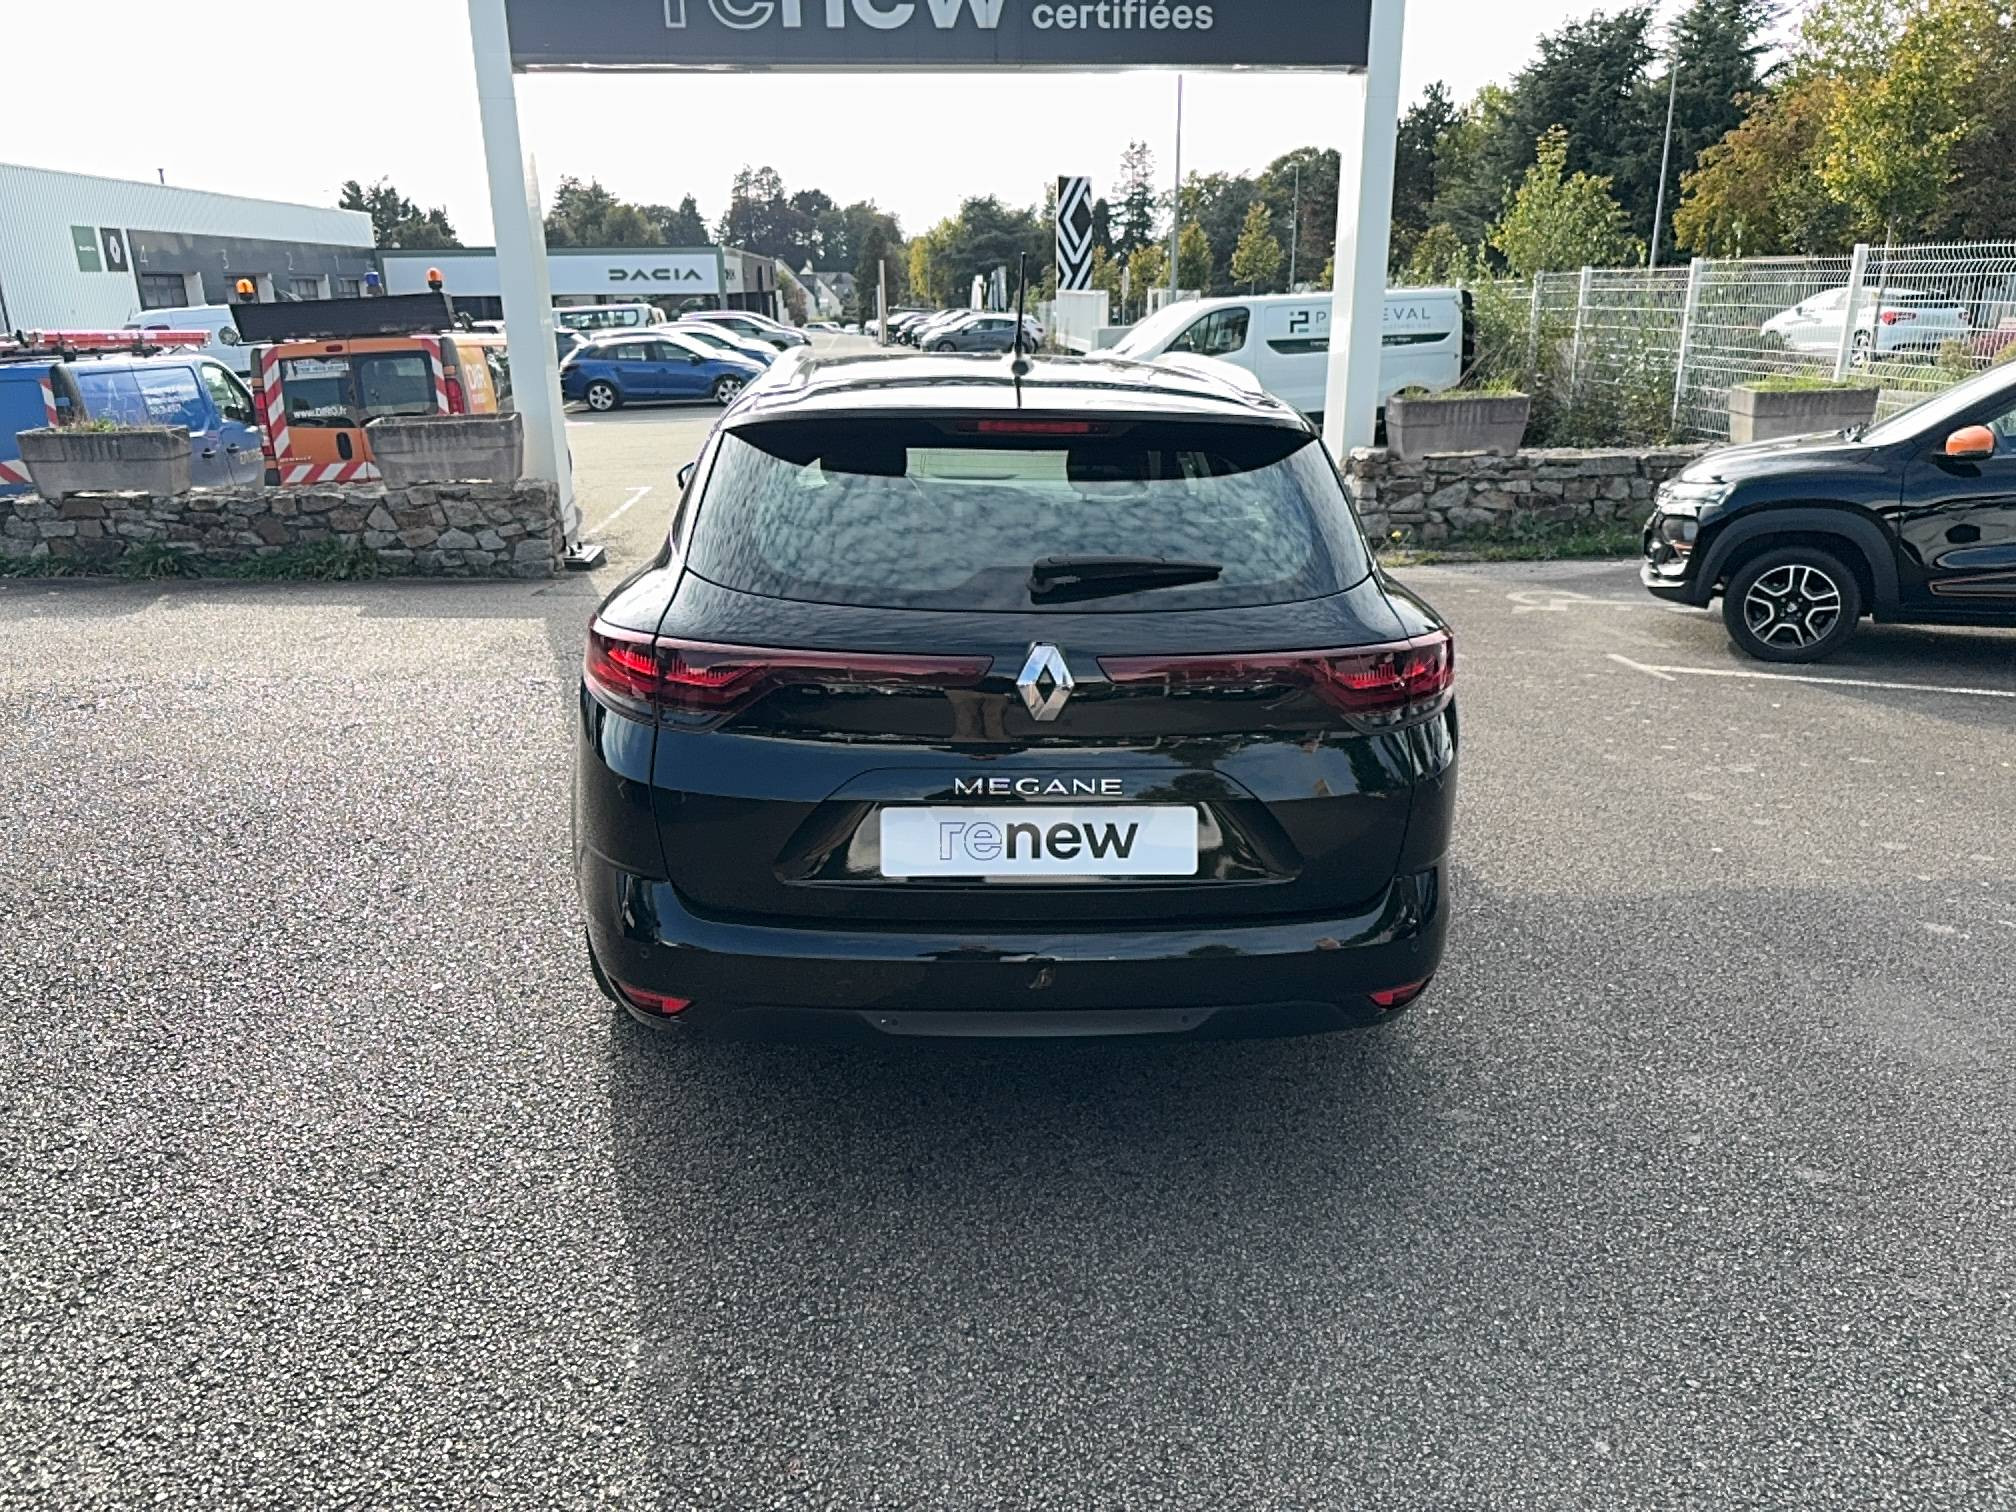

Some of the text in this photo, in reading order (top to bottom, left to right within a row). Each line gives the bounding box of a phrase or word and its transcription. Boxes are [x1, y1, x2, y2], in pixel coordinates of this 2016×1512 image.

[1031, 0, 1214, 29] certifiées
[608, 268, 703, 281] DACIA
[954, 778, 1124, 796] MEGANE
[939, 821, 1138, 861] renew
